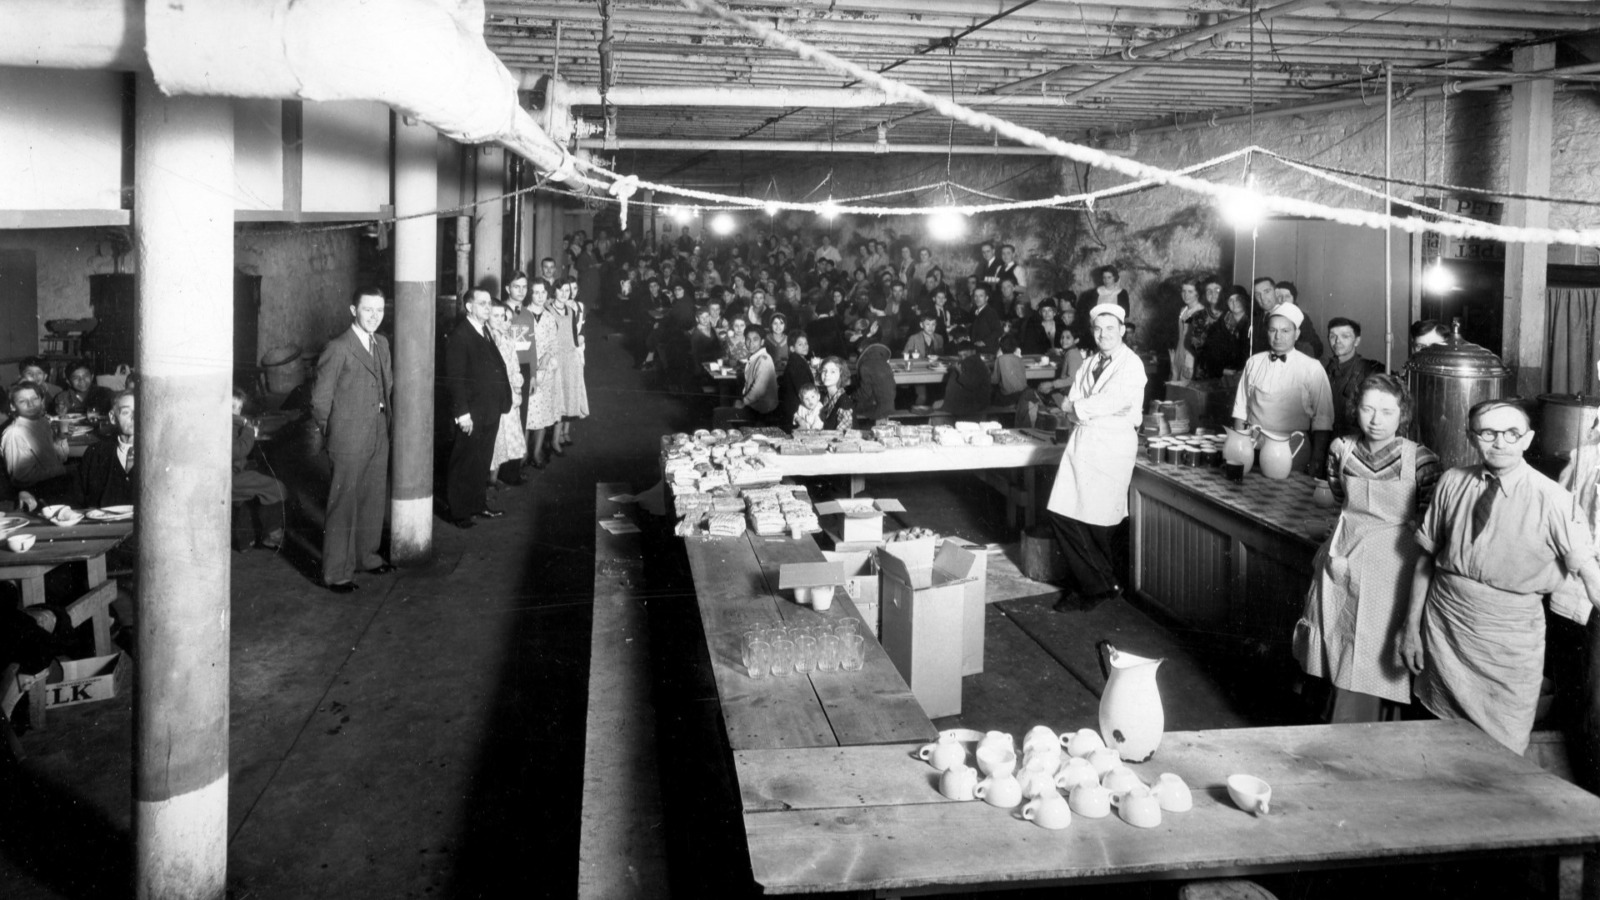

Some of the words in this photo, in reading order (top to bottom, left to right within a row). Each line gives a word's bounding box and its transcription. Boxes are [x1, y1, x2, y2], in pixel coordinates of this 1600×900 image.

[1456, 200, 1498, 216] PET
[511, 325, 530, 342] K
[46, 683, 92, 706] LK
